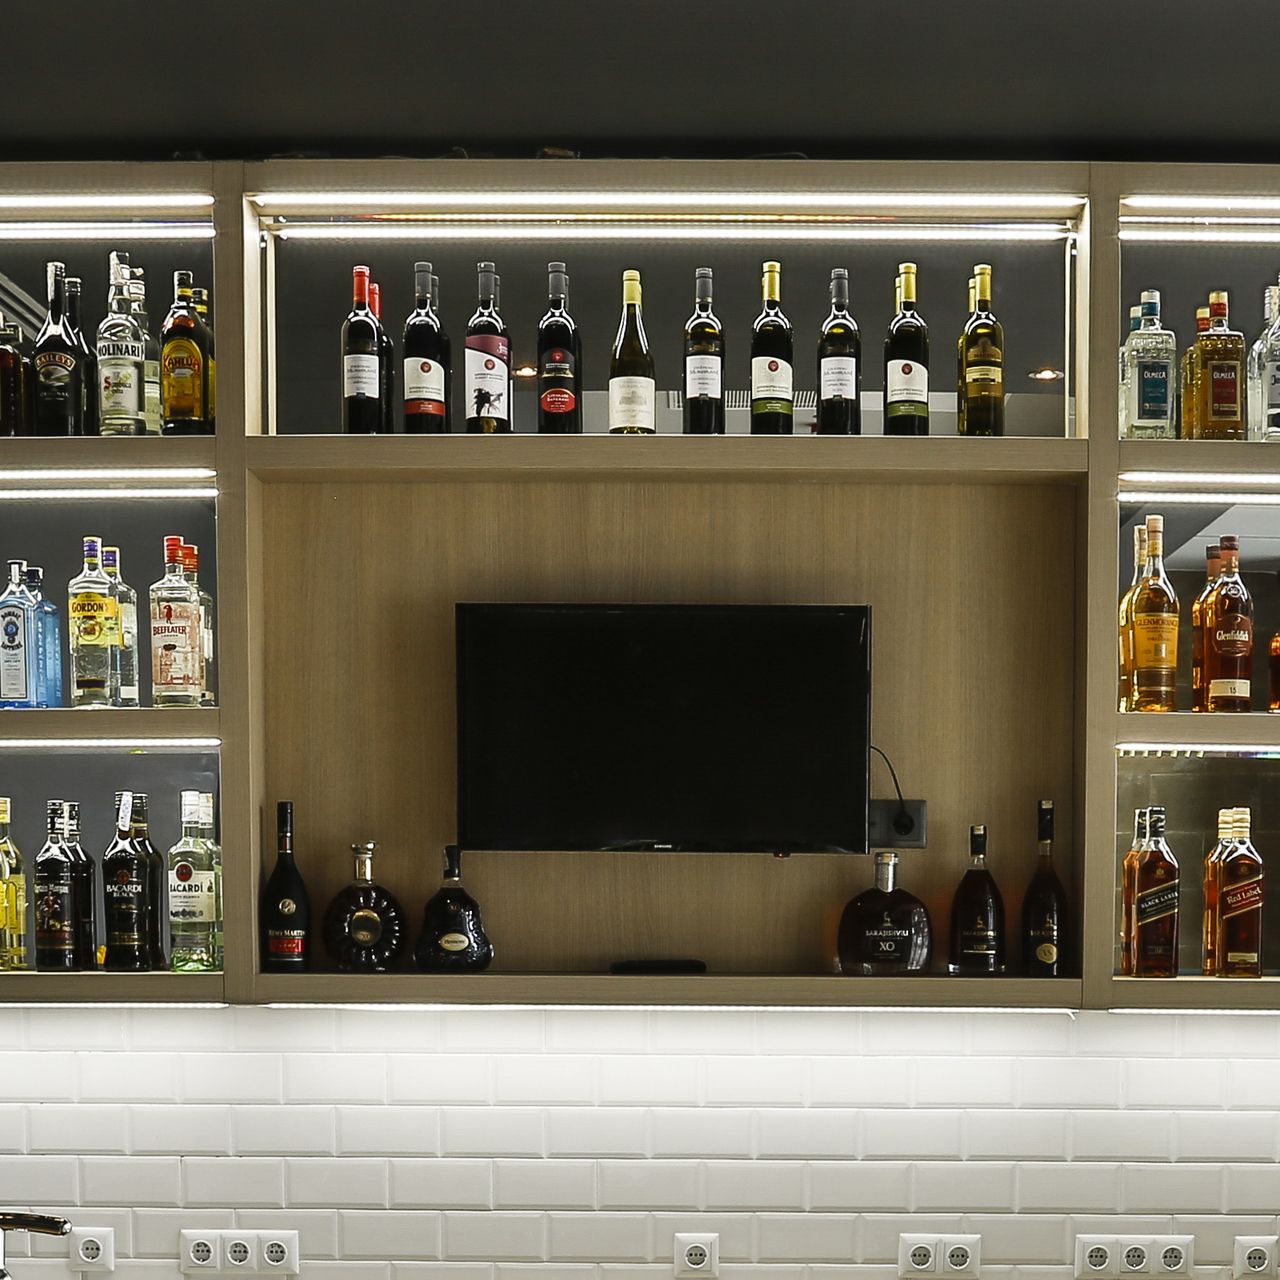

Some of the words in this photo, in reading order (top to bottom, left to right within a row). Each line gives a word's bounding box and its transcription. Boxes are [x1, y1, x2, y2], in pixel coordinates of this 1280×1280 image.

[35, 354, 74, 367] BAILEYS
[152, 626, 187, 637] BEEFEATER
[1216, 630, 1249, 641] Glenfiddich
[879, 941, 896, 951] XO
